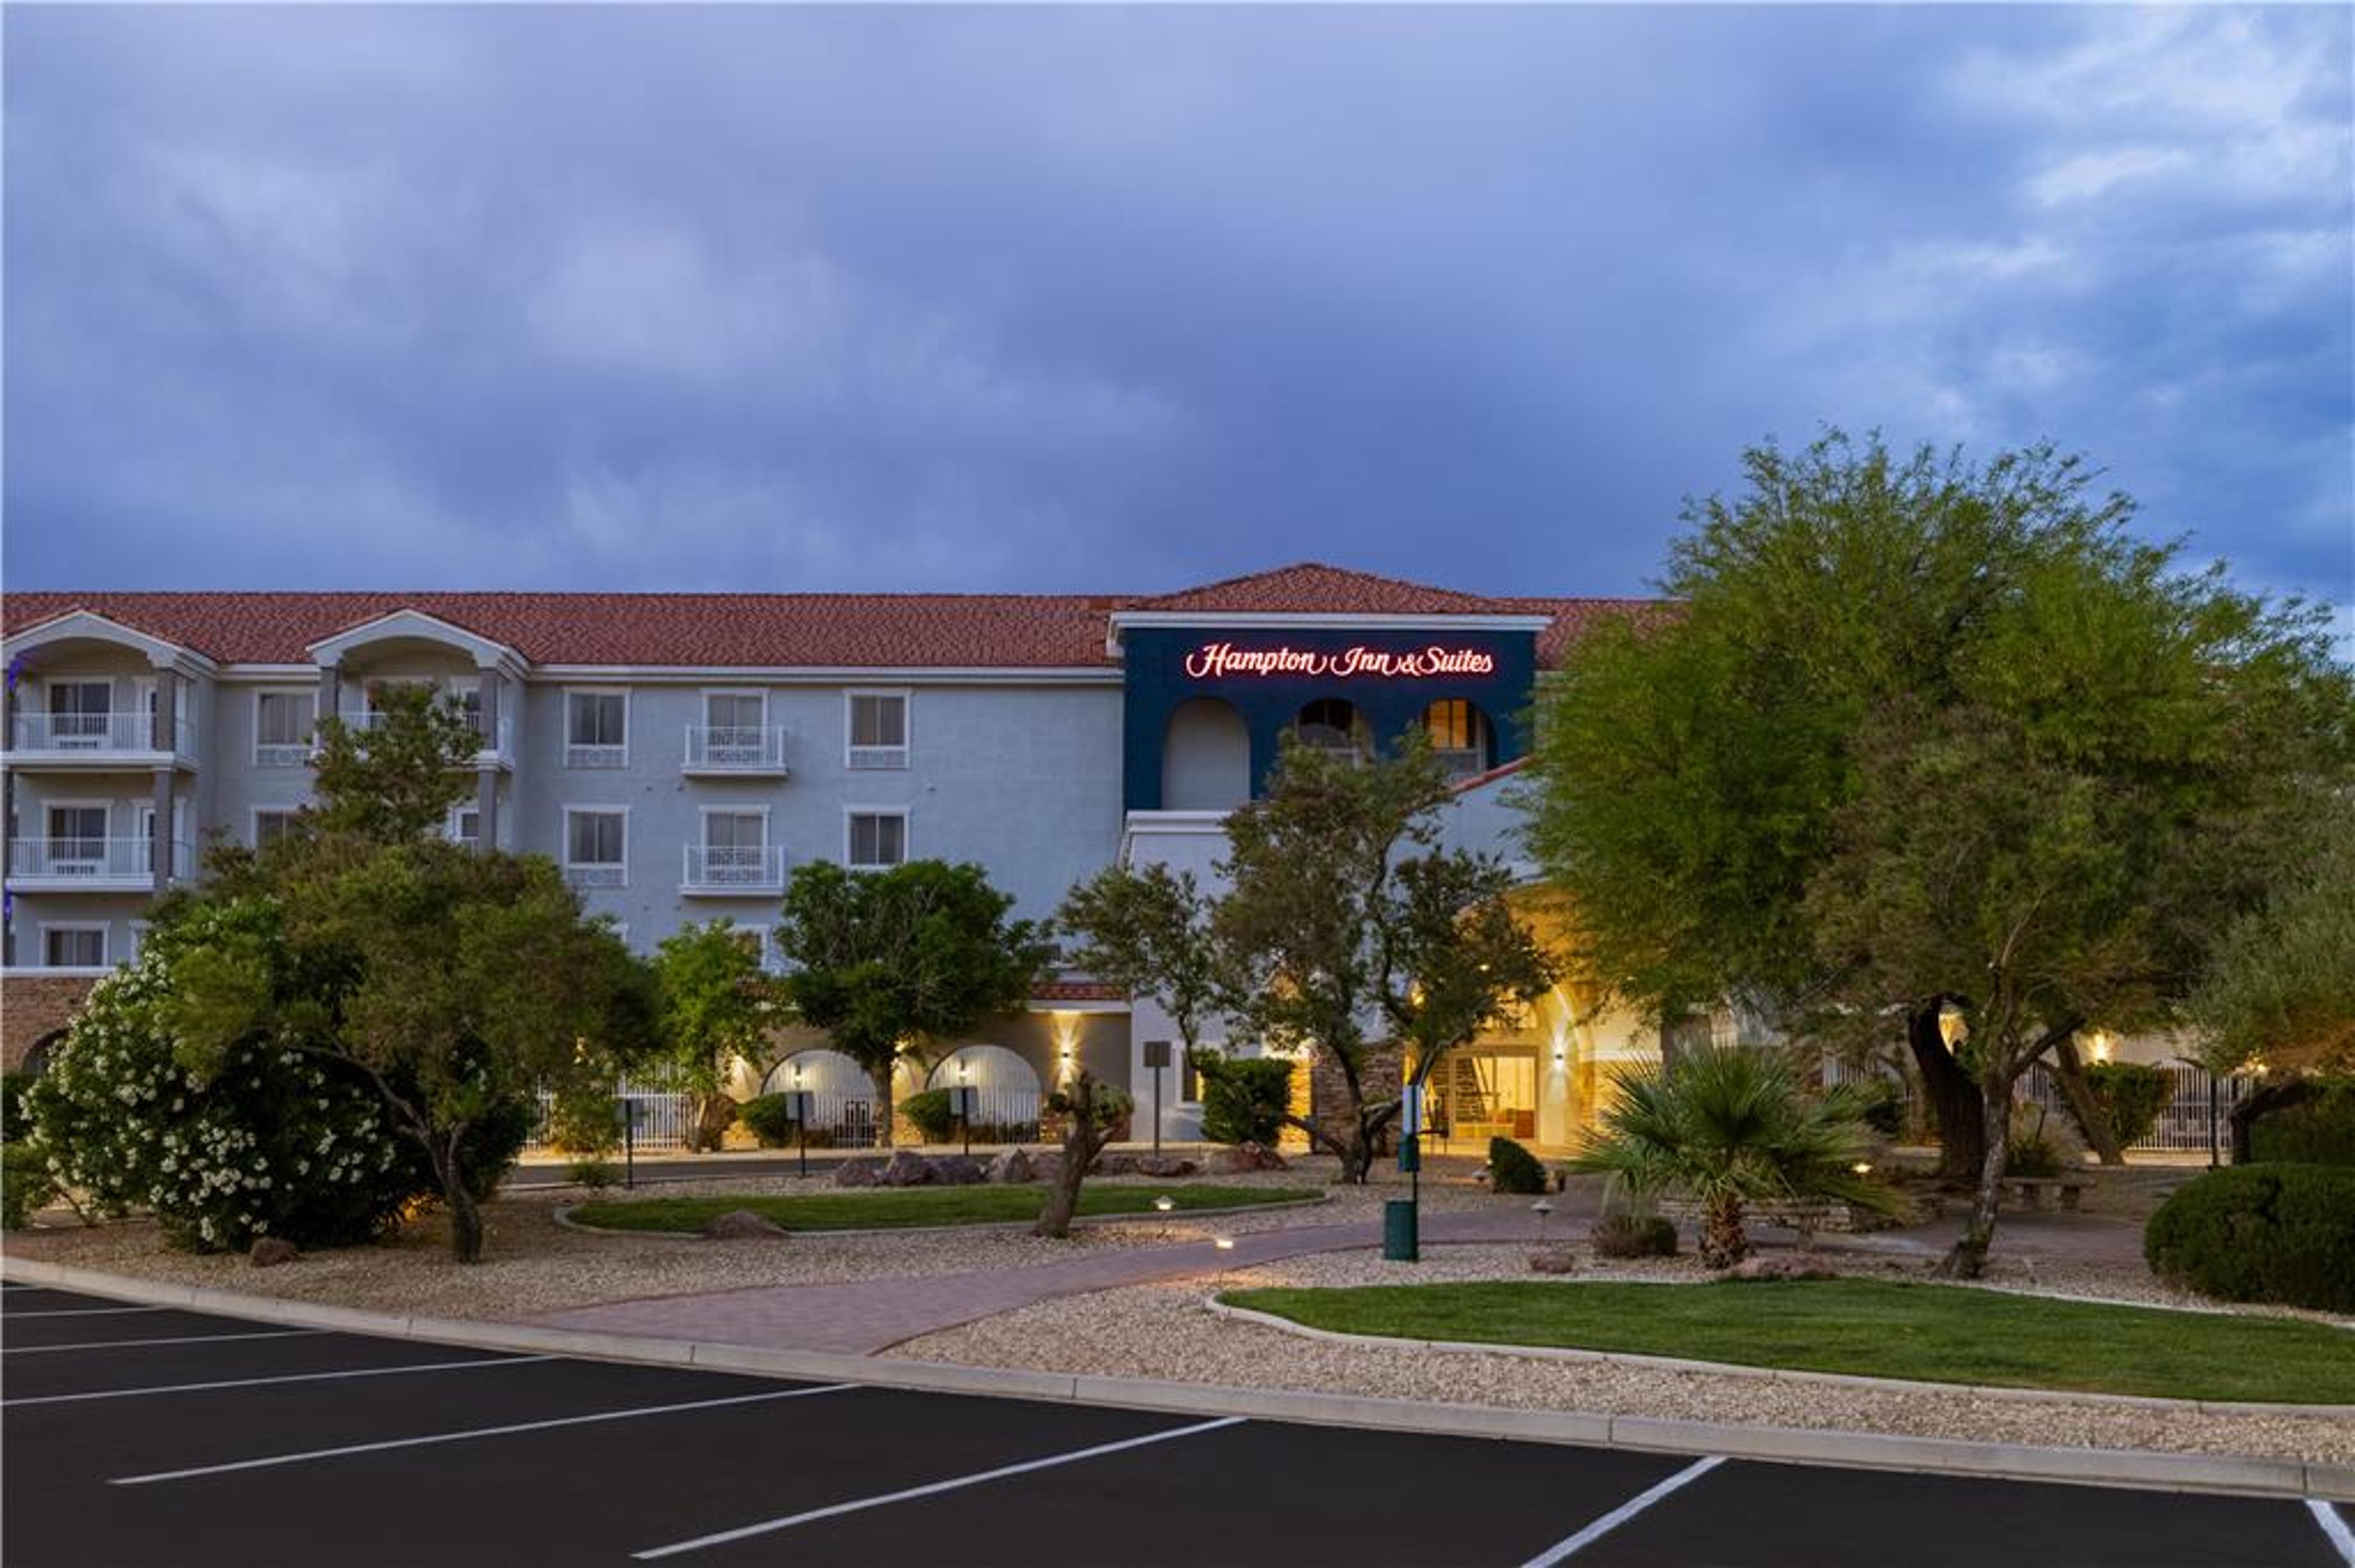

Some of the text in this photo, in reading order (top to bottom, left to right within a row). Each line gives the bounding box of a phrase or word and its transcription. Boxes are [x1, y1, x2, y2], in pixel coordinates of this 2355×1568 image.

[1186, 643, 1328, 677] Hampton
[1330, 646, 1402, 676] Inn
[1416, 646, 1493, 675] Suites
